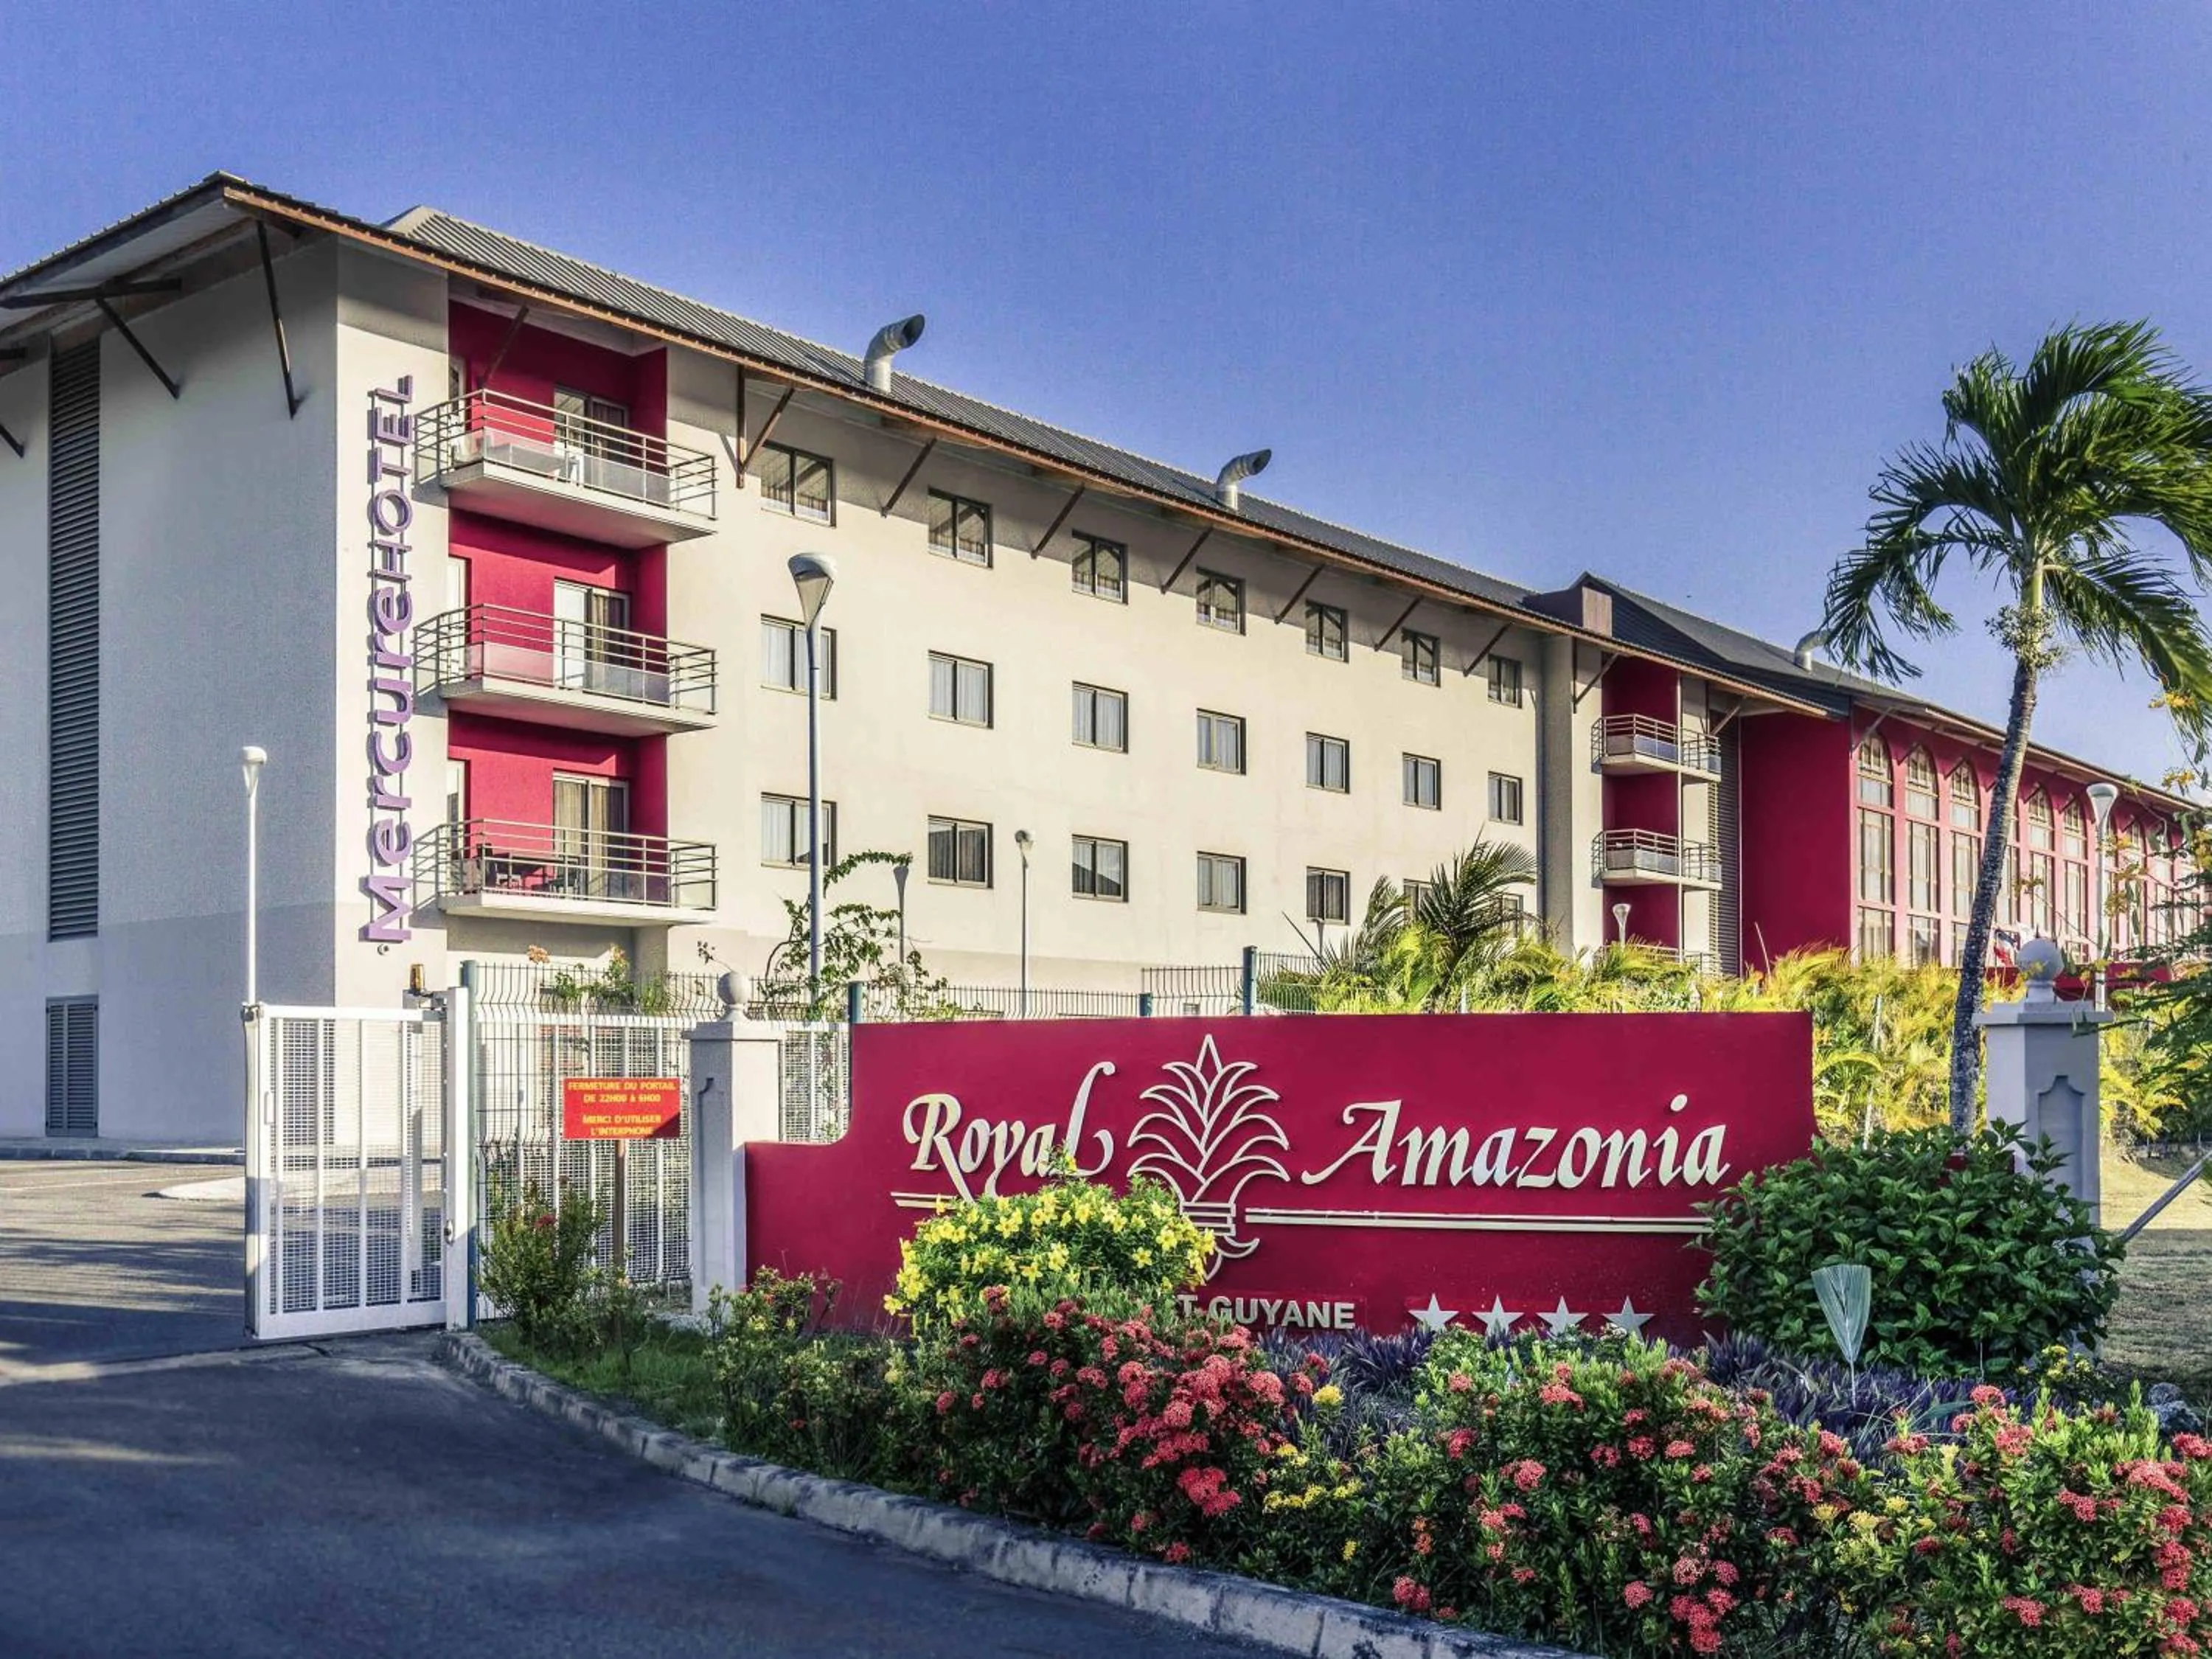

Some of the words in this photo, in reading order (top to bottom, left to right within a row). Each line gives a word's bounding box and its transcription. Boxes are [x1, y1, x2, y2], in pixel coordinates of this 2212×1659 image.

[568, 1082, 621, 1090] FERMETURE
[624, 1082, 638, 1090] DU
[640, 1082, 676, 1090] PORTAIL
[583, 1093, 596, 1102] DE
[582, 1114, 611, 1124] MERCI
[902, 1061, 1115, 1204] Royal
[1301, 1093, 1731, 1188] Amazonia
[1208, 1295, 1355, 1329] GUYANE
